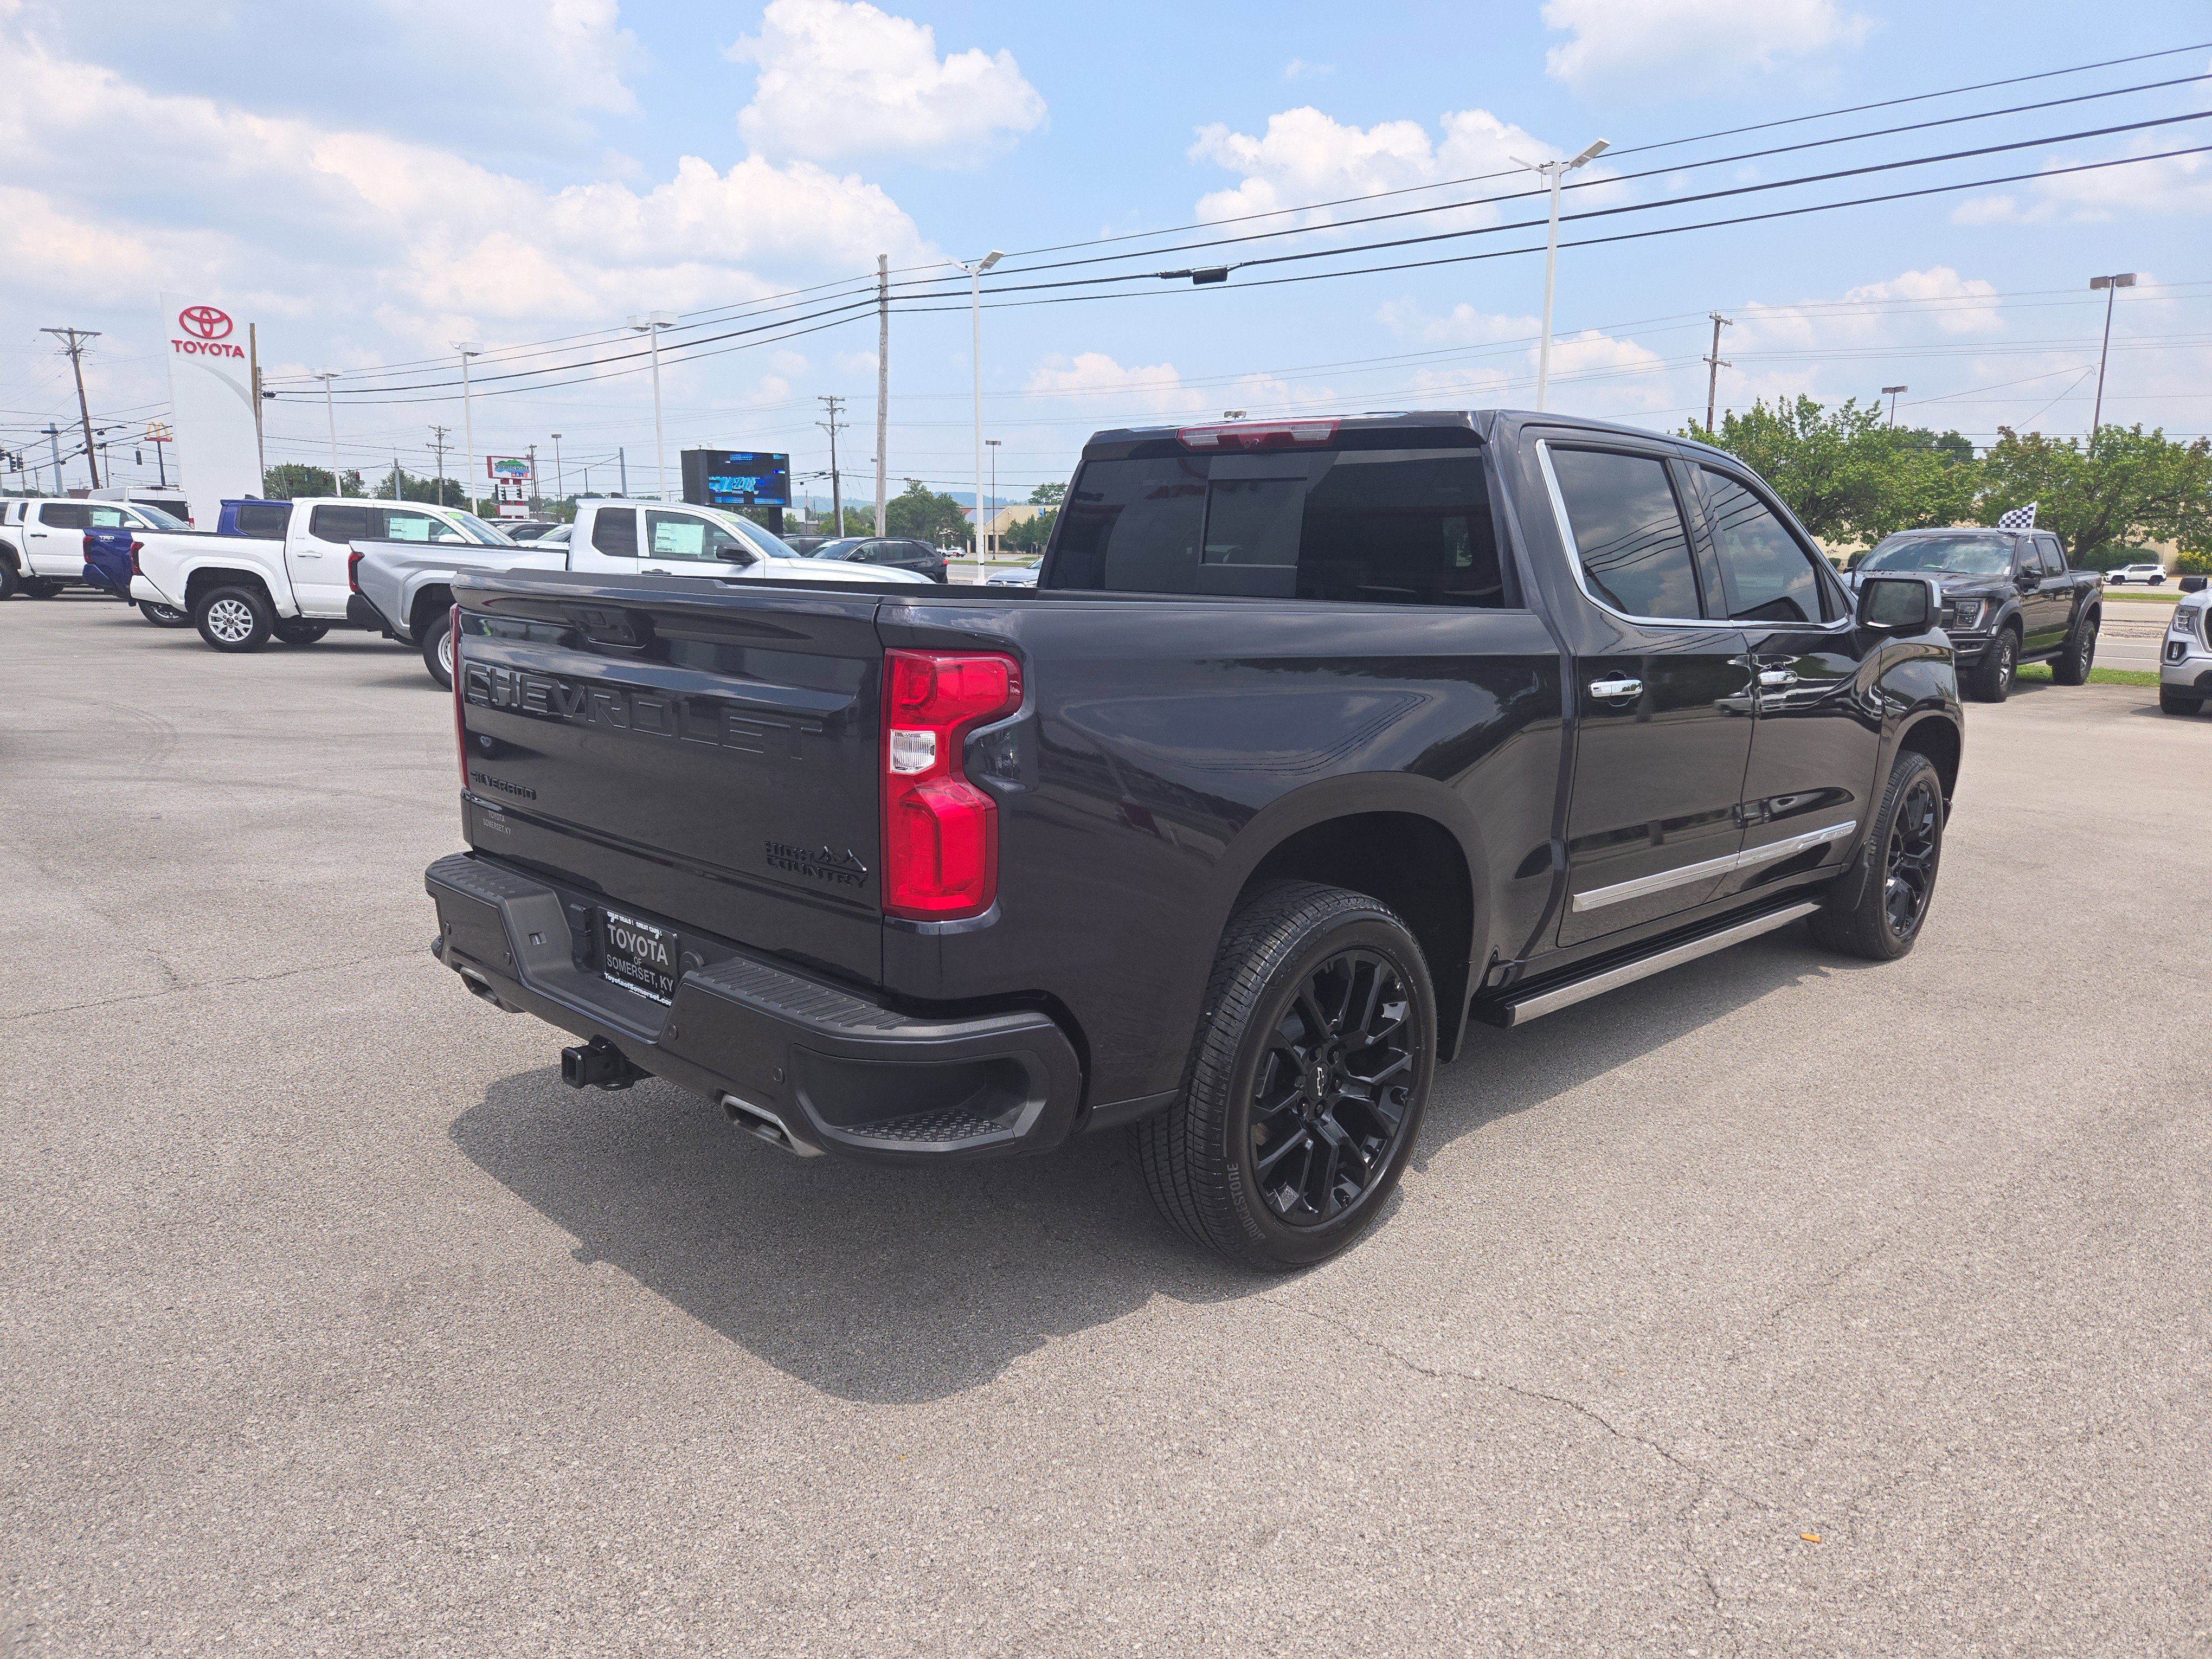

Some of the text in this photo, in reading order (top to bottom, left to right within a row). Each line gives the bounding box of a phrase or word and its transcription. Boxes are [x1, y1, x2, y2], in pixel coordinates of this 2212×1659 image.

[171, 339, 245, 358] TOYOTA
[465, 663, 823, 761] CHEVROLET
[470, 770, 537, 800] SILVERADO
[488, 810, 505, 822] TOYOTA
[764, 841, 814, 862] HIGH
[767, 857, 868, 888] COUNTRY
[607, 924, 668, 966] TOYOTA
[607, 954, 673, 992] SOMERSET, KY
[634, 956, 642, 966] OF
[1227, 1163, 1266, 1244] BRIDGESTONE
